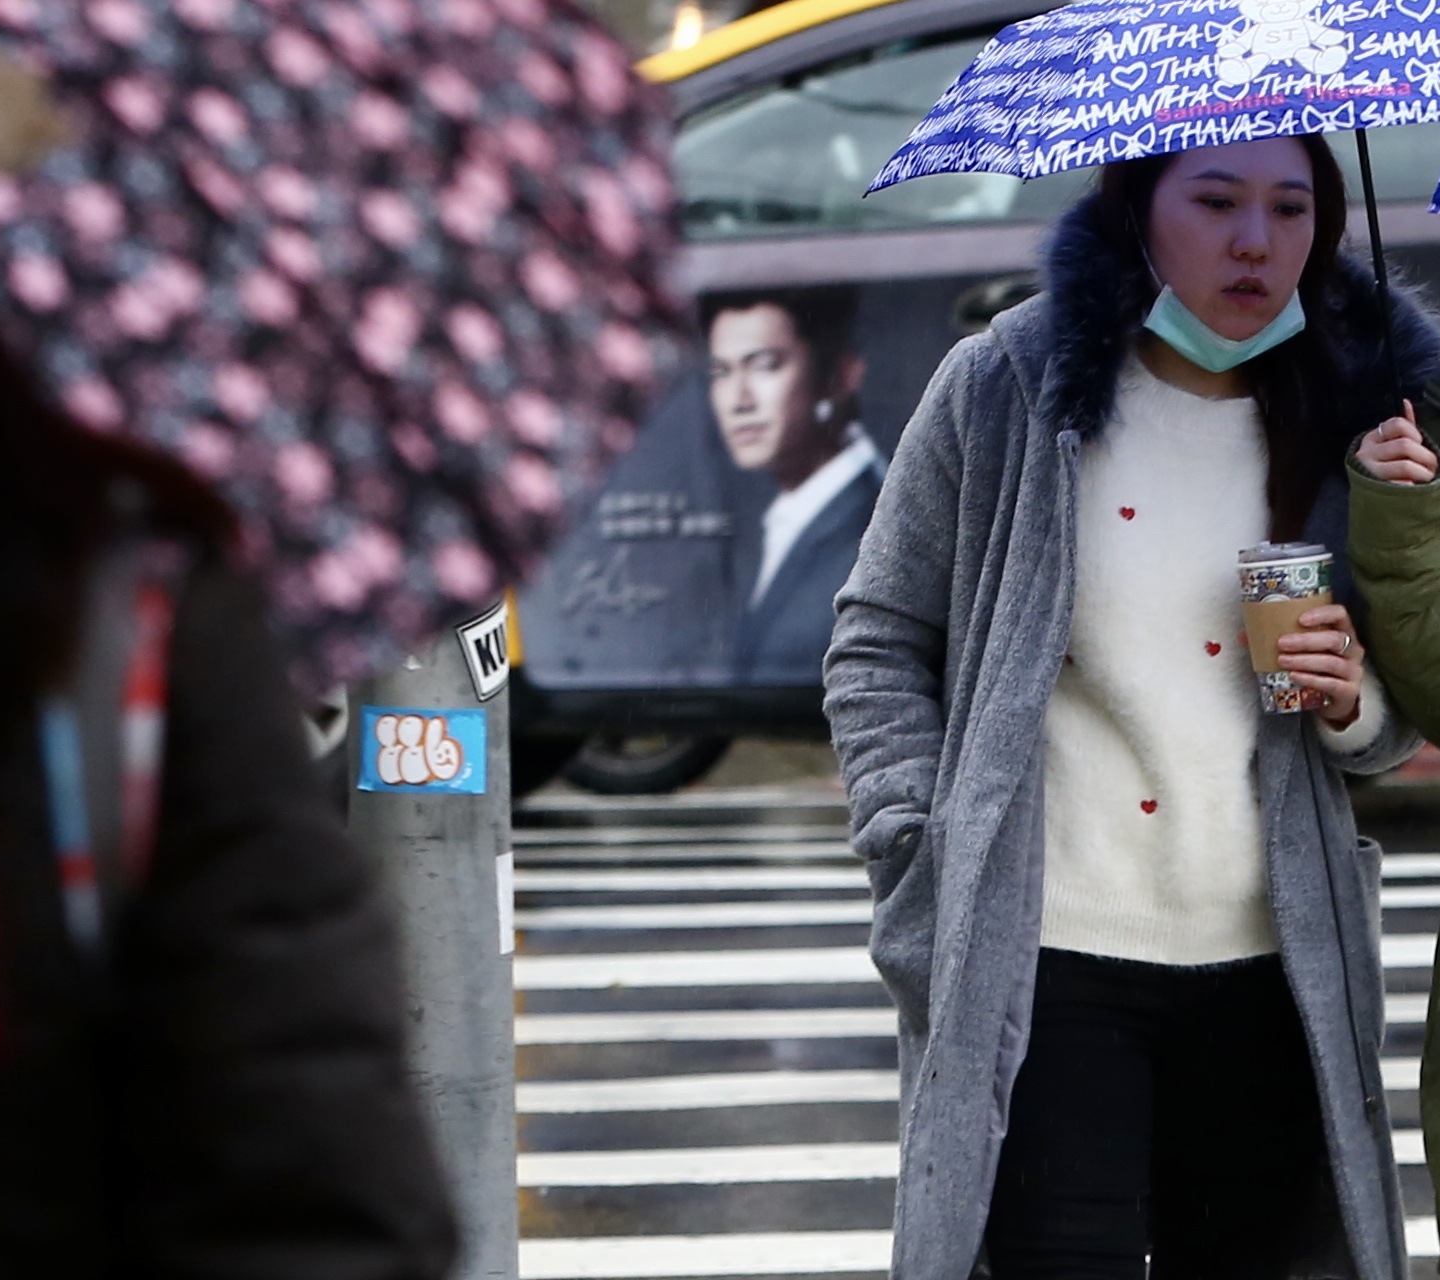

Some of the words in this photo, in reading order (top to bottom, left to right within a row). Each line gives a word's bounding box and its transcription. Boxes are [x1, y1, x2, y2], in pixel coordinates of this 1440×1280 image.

[1265, 28, 1297, 45] ST
[1154, 90, 1286, 123] Samantha
[1158, 109, 1300, 153] THAVASA
